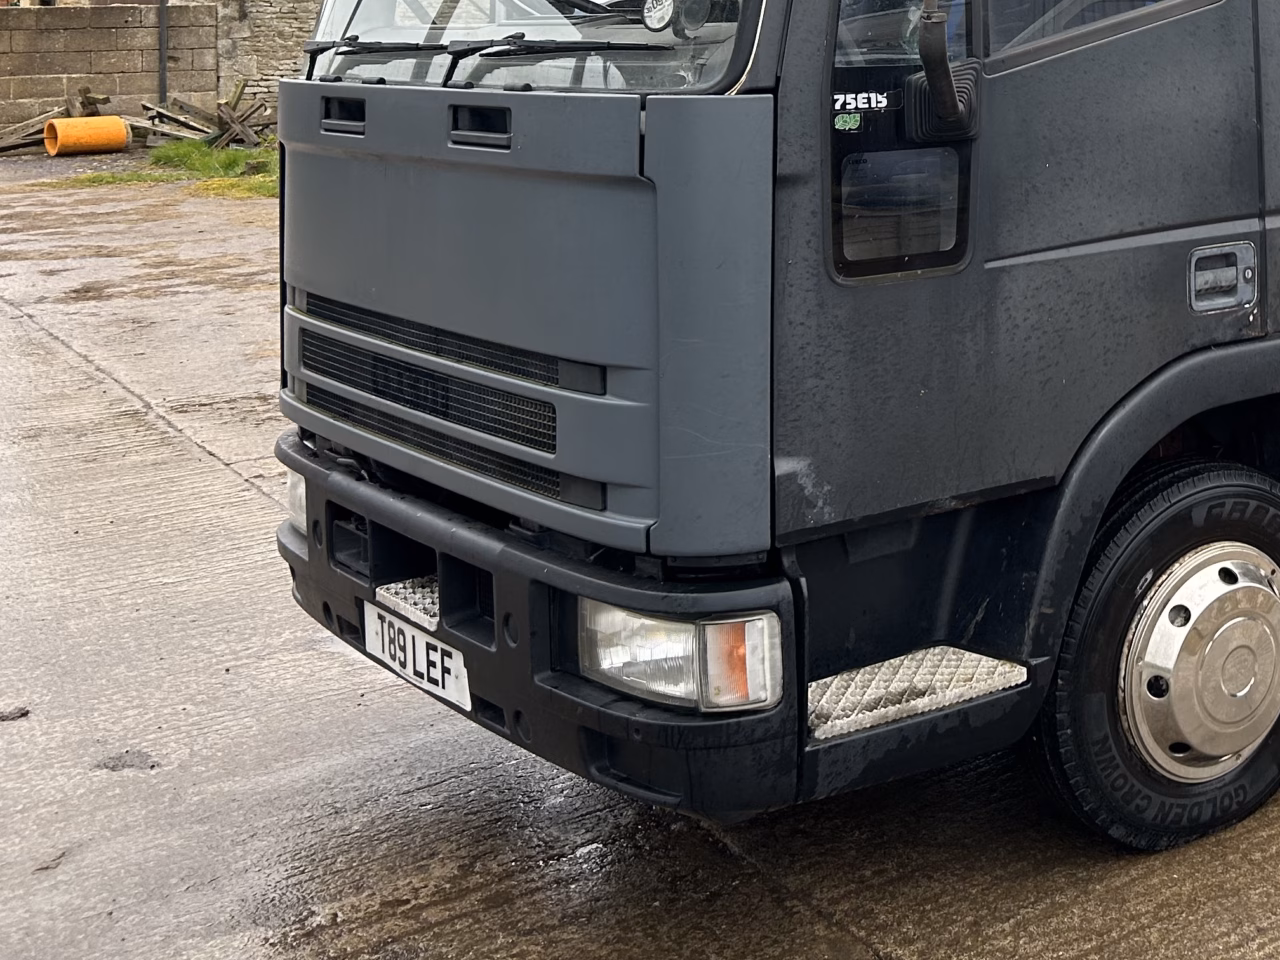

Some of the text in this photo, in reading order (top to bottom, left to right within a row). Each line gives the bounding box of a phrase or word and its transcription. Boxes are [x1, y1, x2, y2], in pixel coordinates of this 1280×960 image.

[833, 92, 888, 110] 75E15
[377, 611, 453, 690] T89 LEF
[1091, 734, 1249, 826] GOLDEN CROWN
